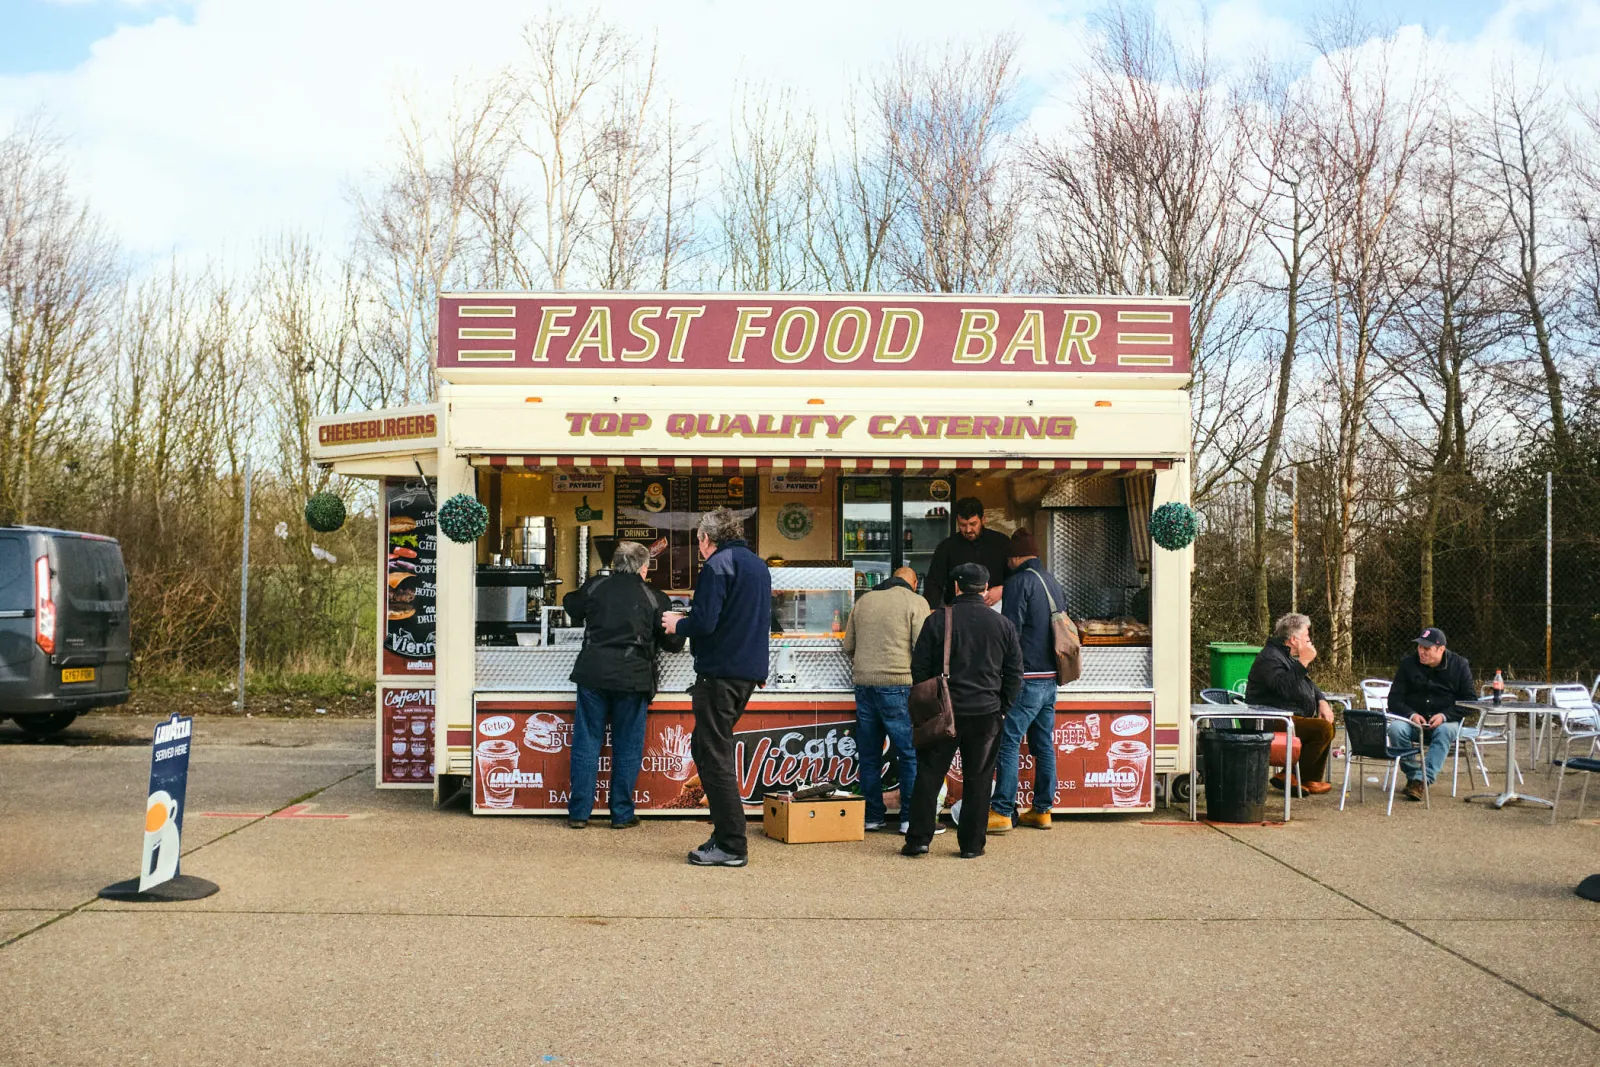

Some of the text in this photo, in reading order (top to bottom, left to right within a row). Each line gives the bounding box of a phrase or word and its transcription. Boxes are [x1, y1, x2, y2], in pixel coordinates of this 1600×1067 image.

[532, 306, 1102, 365] FAST FOOD BAR
[318, 413, 438, 447] CHEESEBURGERS
[565, 412, 1078, 440] TOP QUALITY CATERING
[624, 529, 649, 537] DRINKS
[155, 716, 191, 745] LAVAZZA
[482, 720, 512, 732] Tetley
[155, 743, 188, 762] SERVED HERE
[780, 728, 857, 760] Café
[641, 756, 682, 772] CHIPS
[735, 737, 890, 799] Vienn
[1084, 768, 1136, 782] LAVAZZA
[490, 769, 543, 783] LAVAZZA
